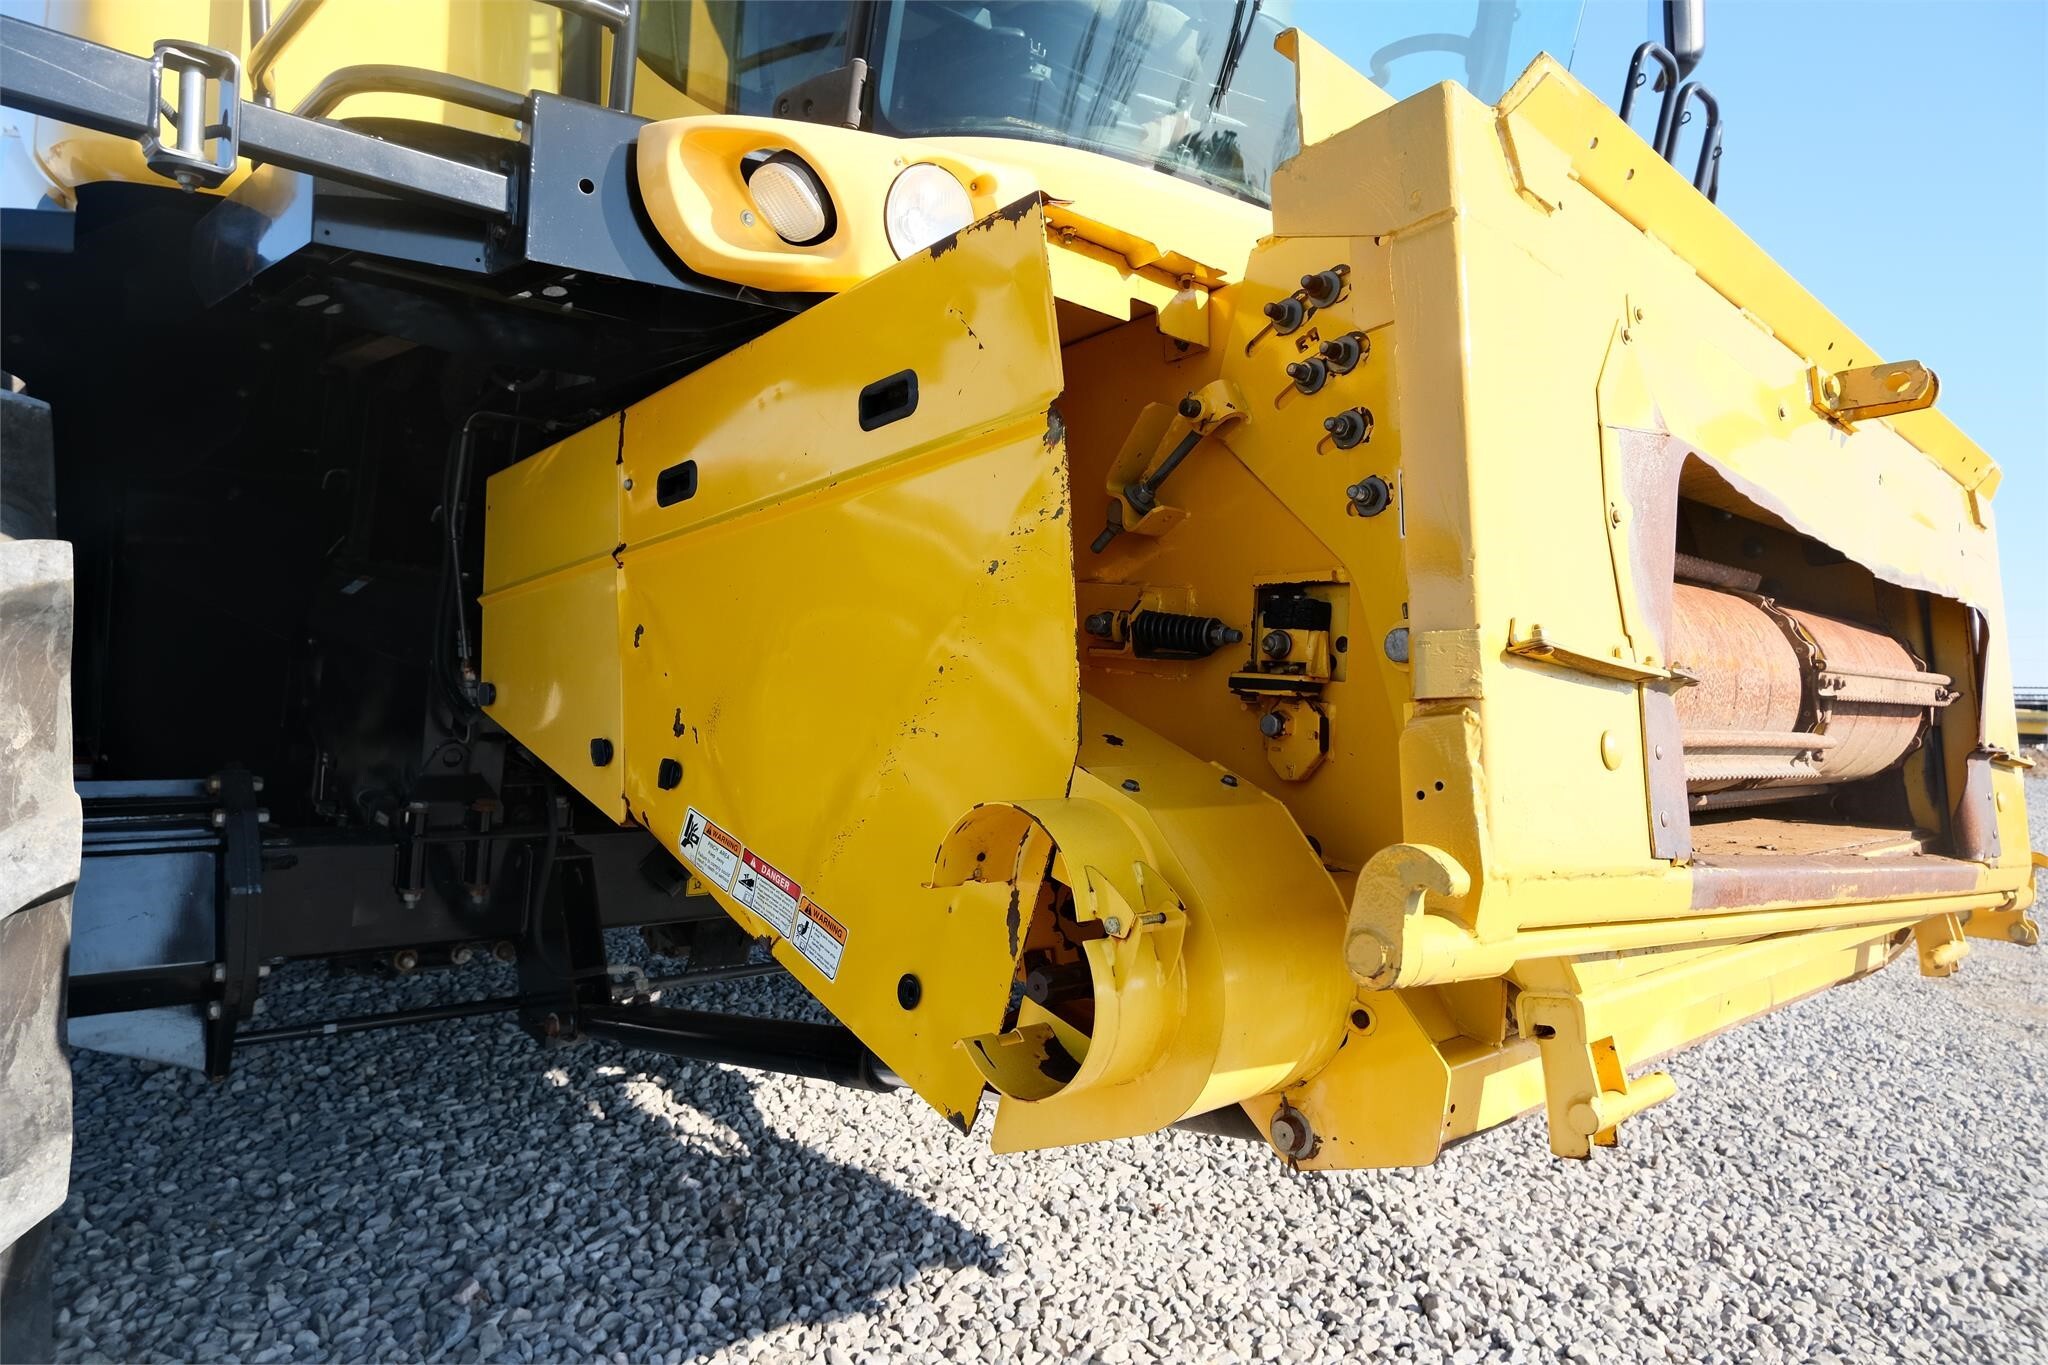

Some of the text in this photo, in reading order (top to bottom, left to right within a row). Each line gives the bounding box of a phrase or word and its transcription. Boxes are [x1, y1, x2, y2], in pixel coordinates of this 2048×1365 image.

[712, 830, 738, 852] WARNING
[719, 850, 730, 859] AREA
[761, 865, 790, 891] DANGER
[813, 909, 842, 938] WARNING
